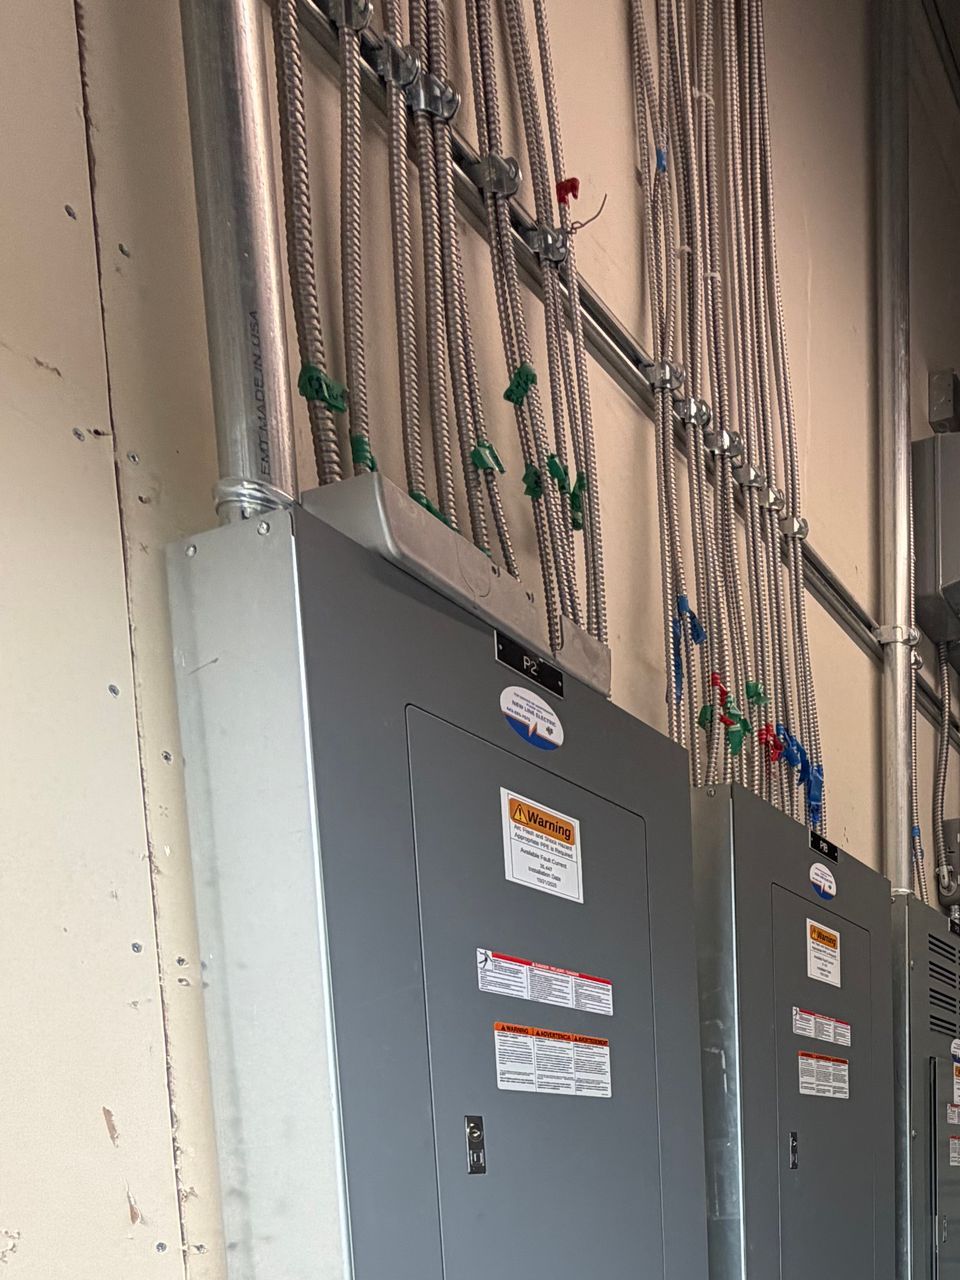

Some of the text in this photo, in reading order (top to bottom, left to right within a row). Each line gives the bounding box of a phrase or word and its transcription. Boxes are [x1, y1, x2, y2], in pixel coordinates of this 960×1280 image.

[248, 310, 271, 476] EMT MADE IN USA
[523, 655, 538, 677] P2
[511, 699, 524, 710] NEW
[527, 809, 572, 842] Warning
[540, 854, 551, 863] Fault
[506, 1026, 529, 1034] WARNING
